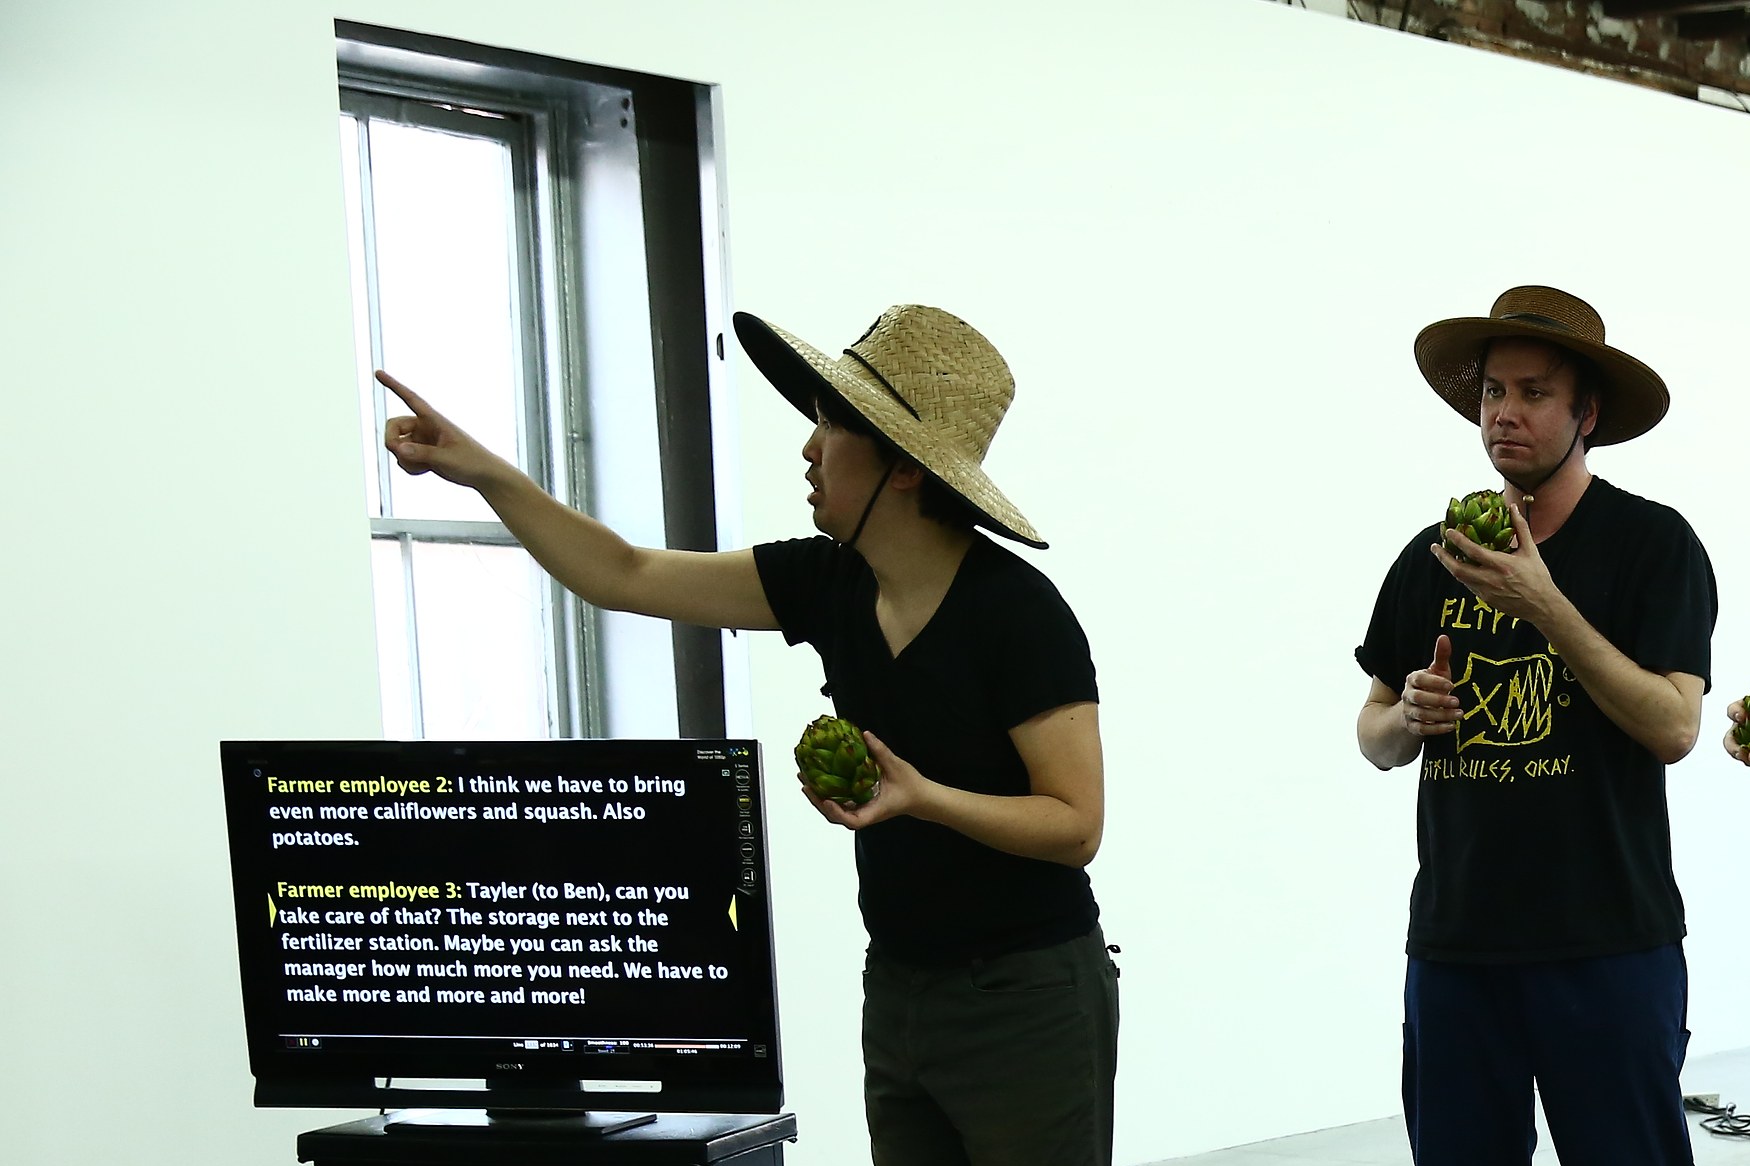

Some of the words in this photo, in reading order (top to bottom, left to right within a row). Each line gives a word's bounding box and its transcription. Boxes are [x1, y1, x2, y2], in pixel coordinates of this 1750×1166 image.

[1524, 754, 1575, 778] OKAY.
[267, 776, 335, 793] Farmer
[339, 775, 431, 797] employee
[435, 776, 453, 793] 2:
[458, 776, 465, 793] I
[468, 775, 521, 794] think
[524, 779, 553, 794] we
[557, 775, 604, 794] have
[607, 777, 629, 793] to
[633, 775, 686, 797] bring
[269, 806, 314, 820] even
[319, 806, 369, 820] more
[373, 801, 478, 820] califlowers
[482, 801, 518, 820] and
[523, 801, 598, 824] squash.
[602, 801, 646, 820] Also
[272, 830, 360, 850] potatoes.
[277, 881, 344, 898] Farmer
[348, 880, 440, 903] employee
[445, 881, 462, 899] 3:
[465, 881, 528, 903] Tayler
[531, 881, 559, 902] (to
[563, 881, 611, 903] Ben),
[615, 886, 649, 900] can
[653, 886, 690, 904] you
[278, 906, 321, 924] take
[324, 911, 365, 925] care
[369, 906, 391, 925] of
[393, 906, 442, 925] that?
[445, 907, 483, 926] The
[488, 910, 560, 930] storage
[565, 910, 608, 926] next
[611, 910, 633, 926] to
[637, 908, 669, 927] the
[280, 932, 364, 951] fertilizer
[368, 933, 440, 951] station.
[443, 933, 506, 955] Maybe
[509, 938, 545, 956] you
[550, 938, 584, 952] can
[588, 934, 623, 953] ask
[627, 934, 659, 953] the
[284, 962, 367, 980] manager
[371, 958, 411, 977] how
[416, 959, 468, 978] much
[473, 964, 523, 978] more
[526, 964, 563, 982] you
[568, 960, 620, 979] need.
[623, 961, 653, 979] We
[657, 961, 704, 980] have
[707, 964, 729, 980] to
[286, 984, 338, 1003] make
[342, 989, 392, 1003] more
[395, 985, 431, 1003] and
[436, 989, 486, 1004] more
[490, 986, 526, 1004] and
[530, 987, 586, 1005] more!
